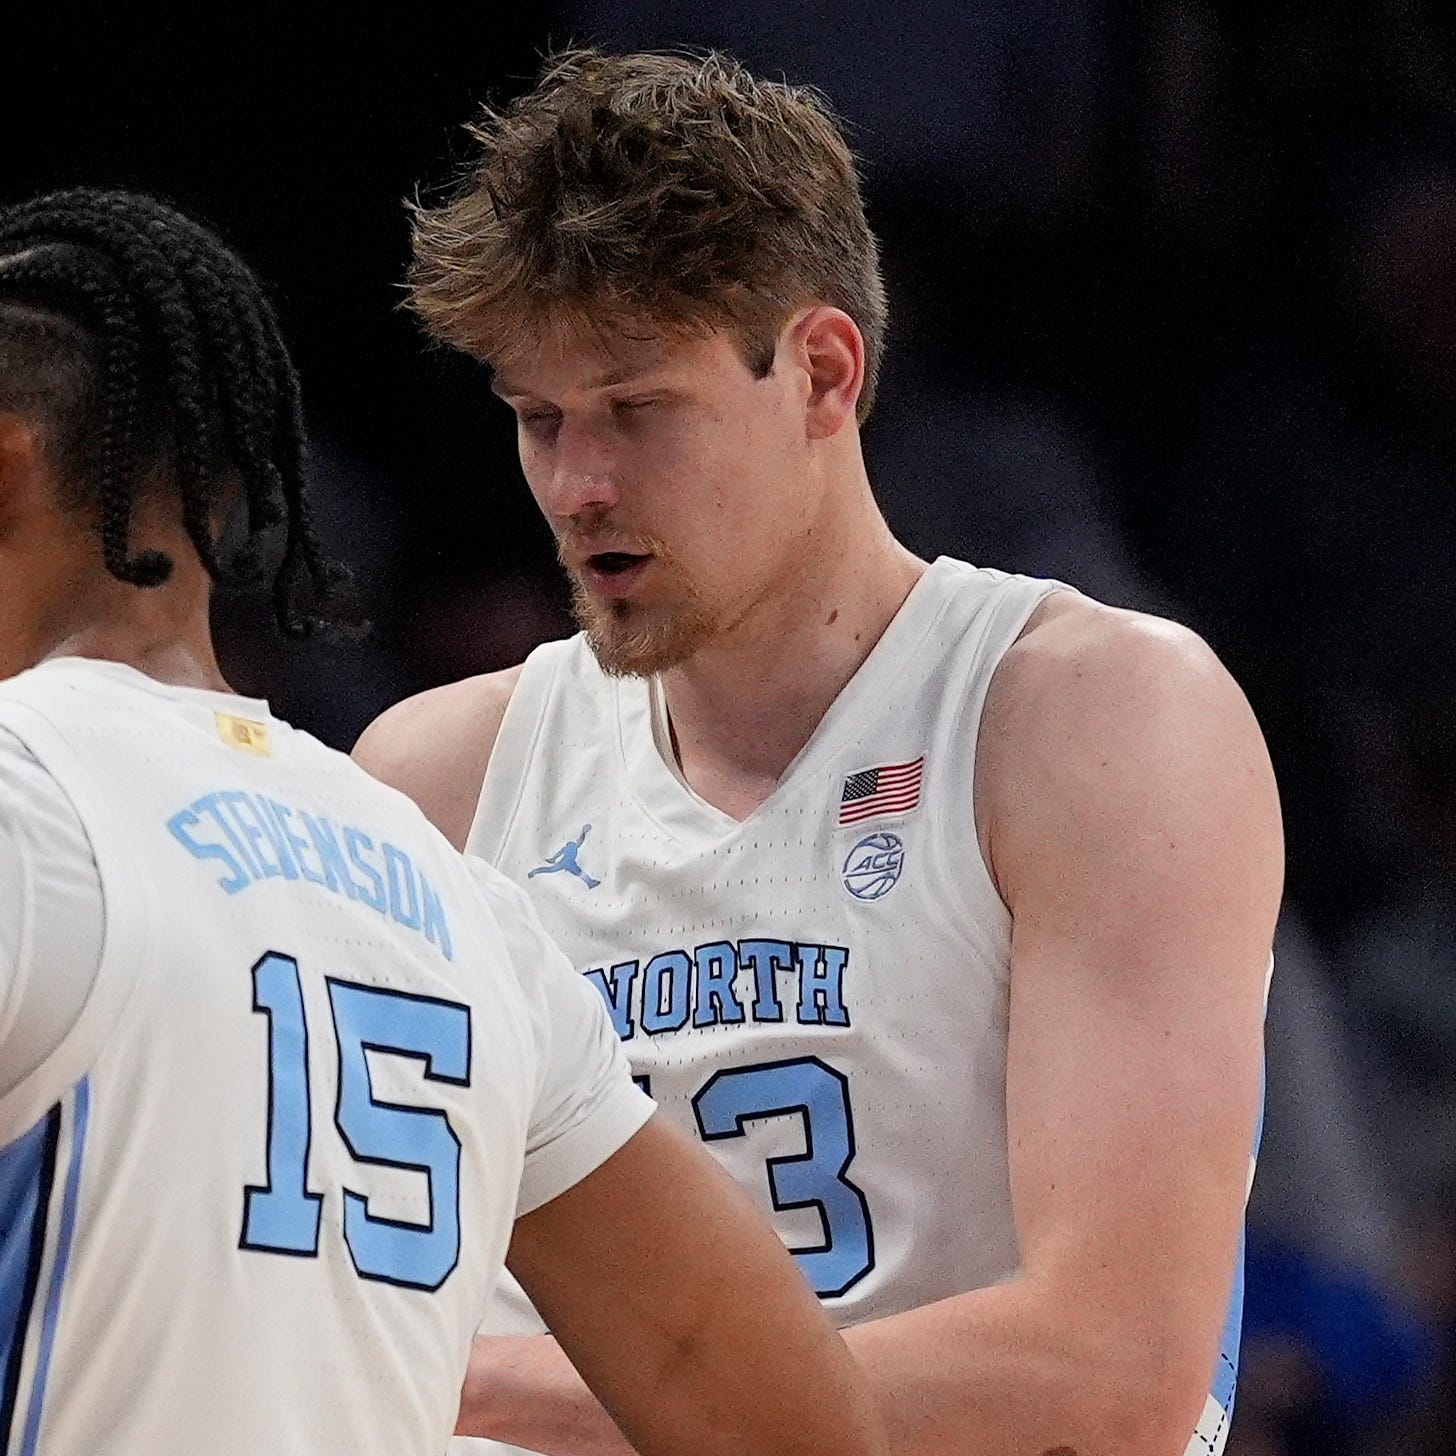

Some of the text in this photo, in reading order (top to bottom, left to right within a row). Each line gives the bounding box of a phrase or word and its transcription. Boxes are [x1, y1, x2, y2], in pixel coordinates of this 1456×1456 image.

[166, 789, 451, 961] STEVENSON
[851, 849, 903, 872] ACC
[583, 938, 851, 1041] NORTH
[238, 950, 471, 1292] 15
[632, 1055, 875, 1298] 3
